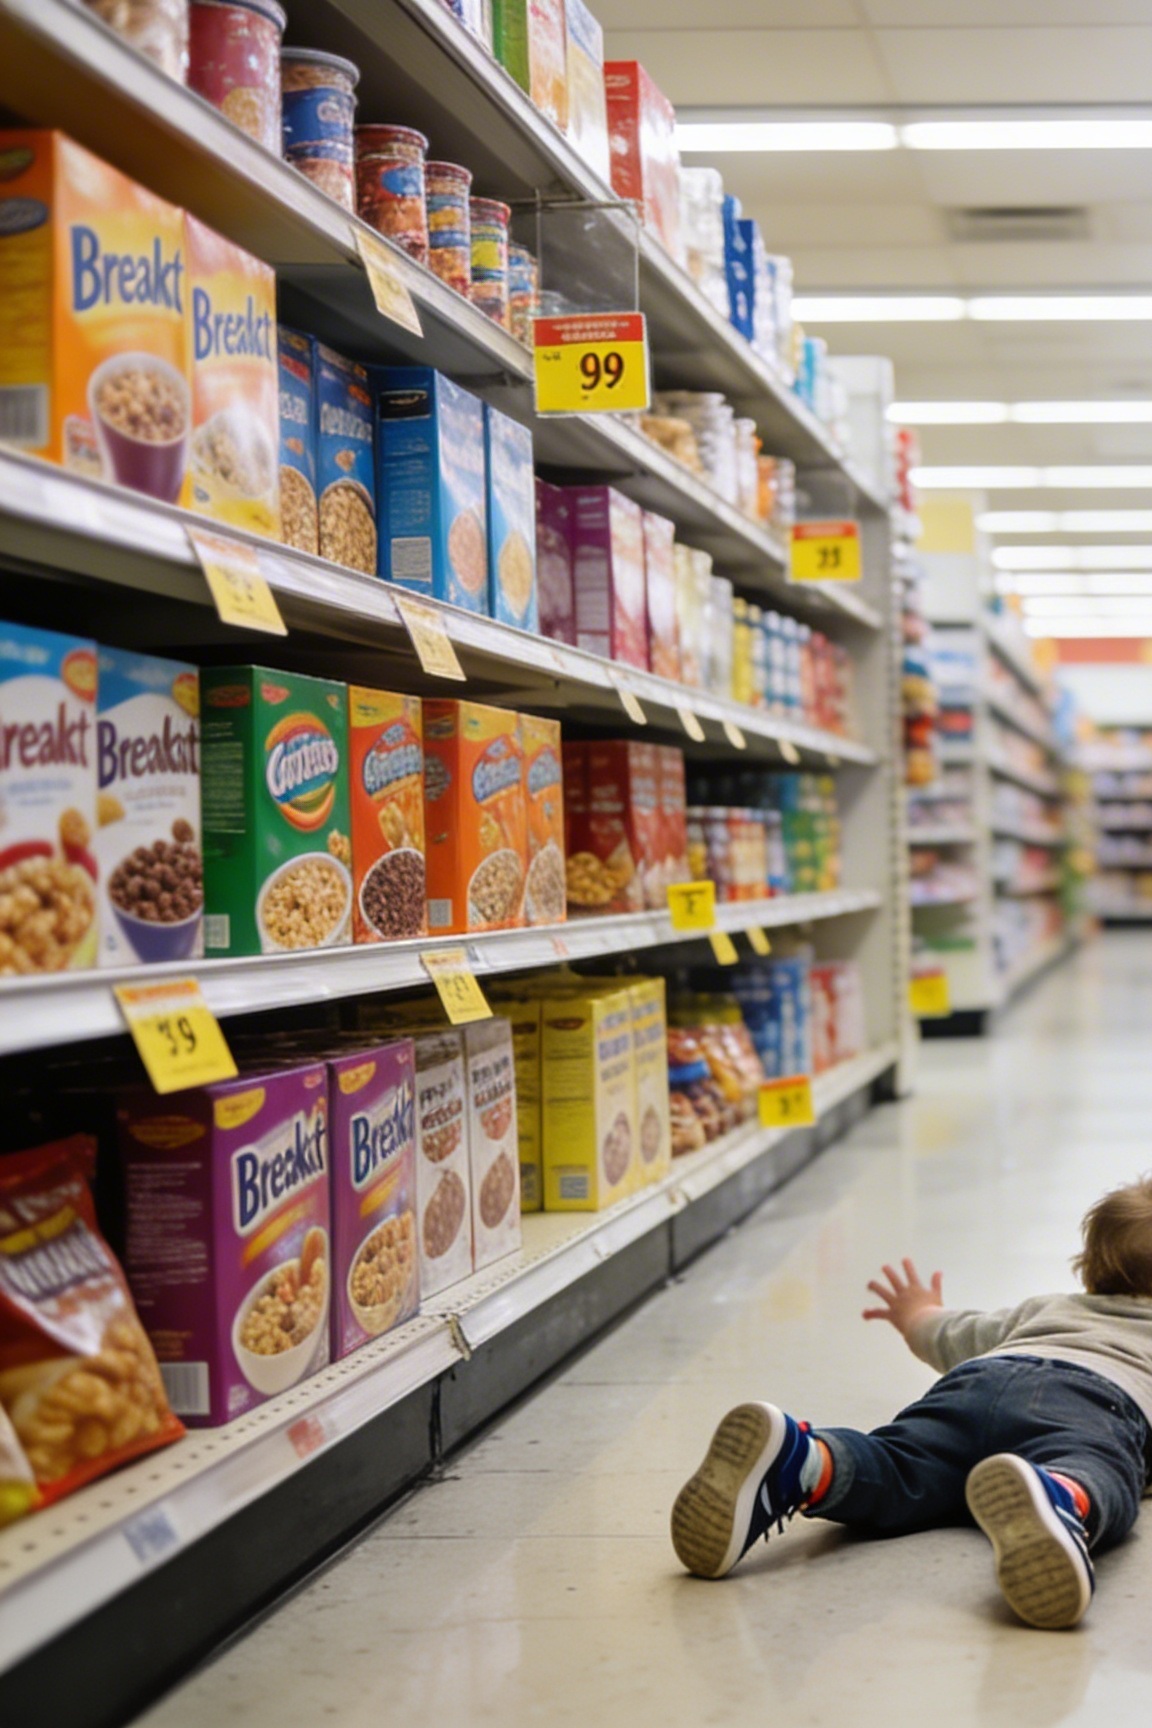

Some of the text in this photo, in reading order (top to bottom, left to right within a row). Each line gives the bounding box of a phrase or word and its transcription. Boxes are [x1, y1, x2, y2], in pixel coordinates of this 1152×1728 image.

[71, 225, 184, 315] Breakt
[580, 352, 625, 390] 99
[0, 702, 91, 770] reakt
